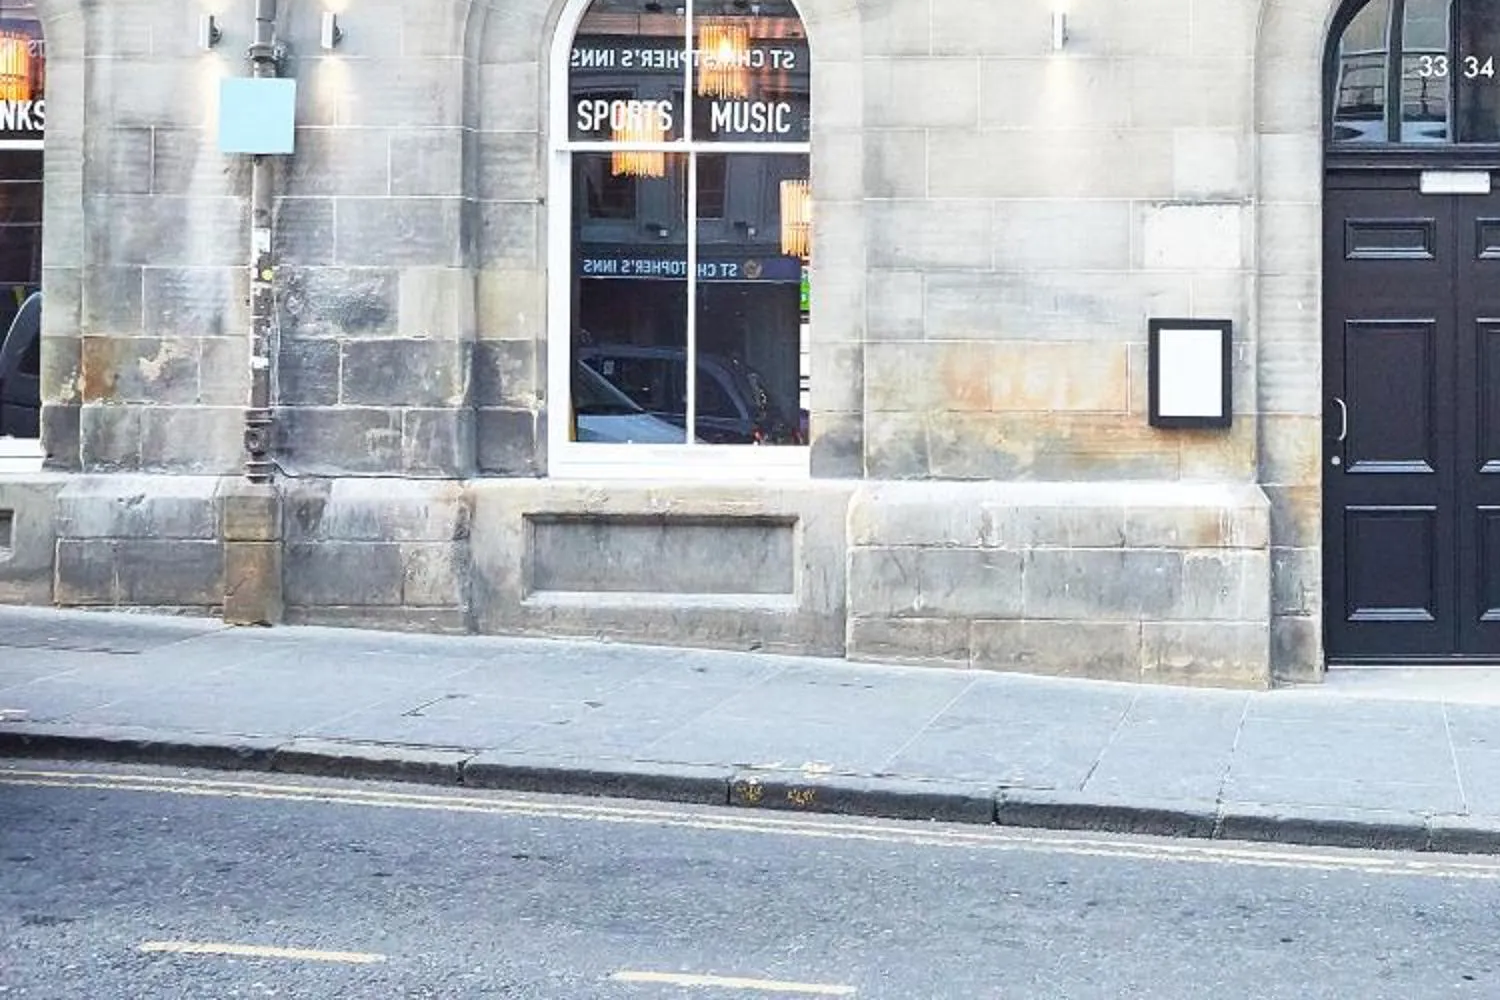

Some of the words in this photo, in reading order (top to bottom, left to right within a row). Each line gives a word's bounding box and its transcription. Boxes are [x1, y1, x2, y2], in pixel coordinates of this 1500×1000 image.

[1419, 55, 1449, 78] 33
[1464, 55, 1495, 79] 34
[577, 100, 673, 132] SPORTS
[711, 101, 791, 133] MUSIC
